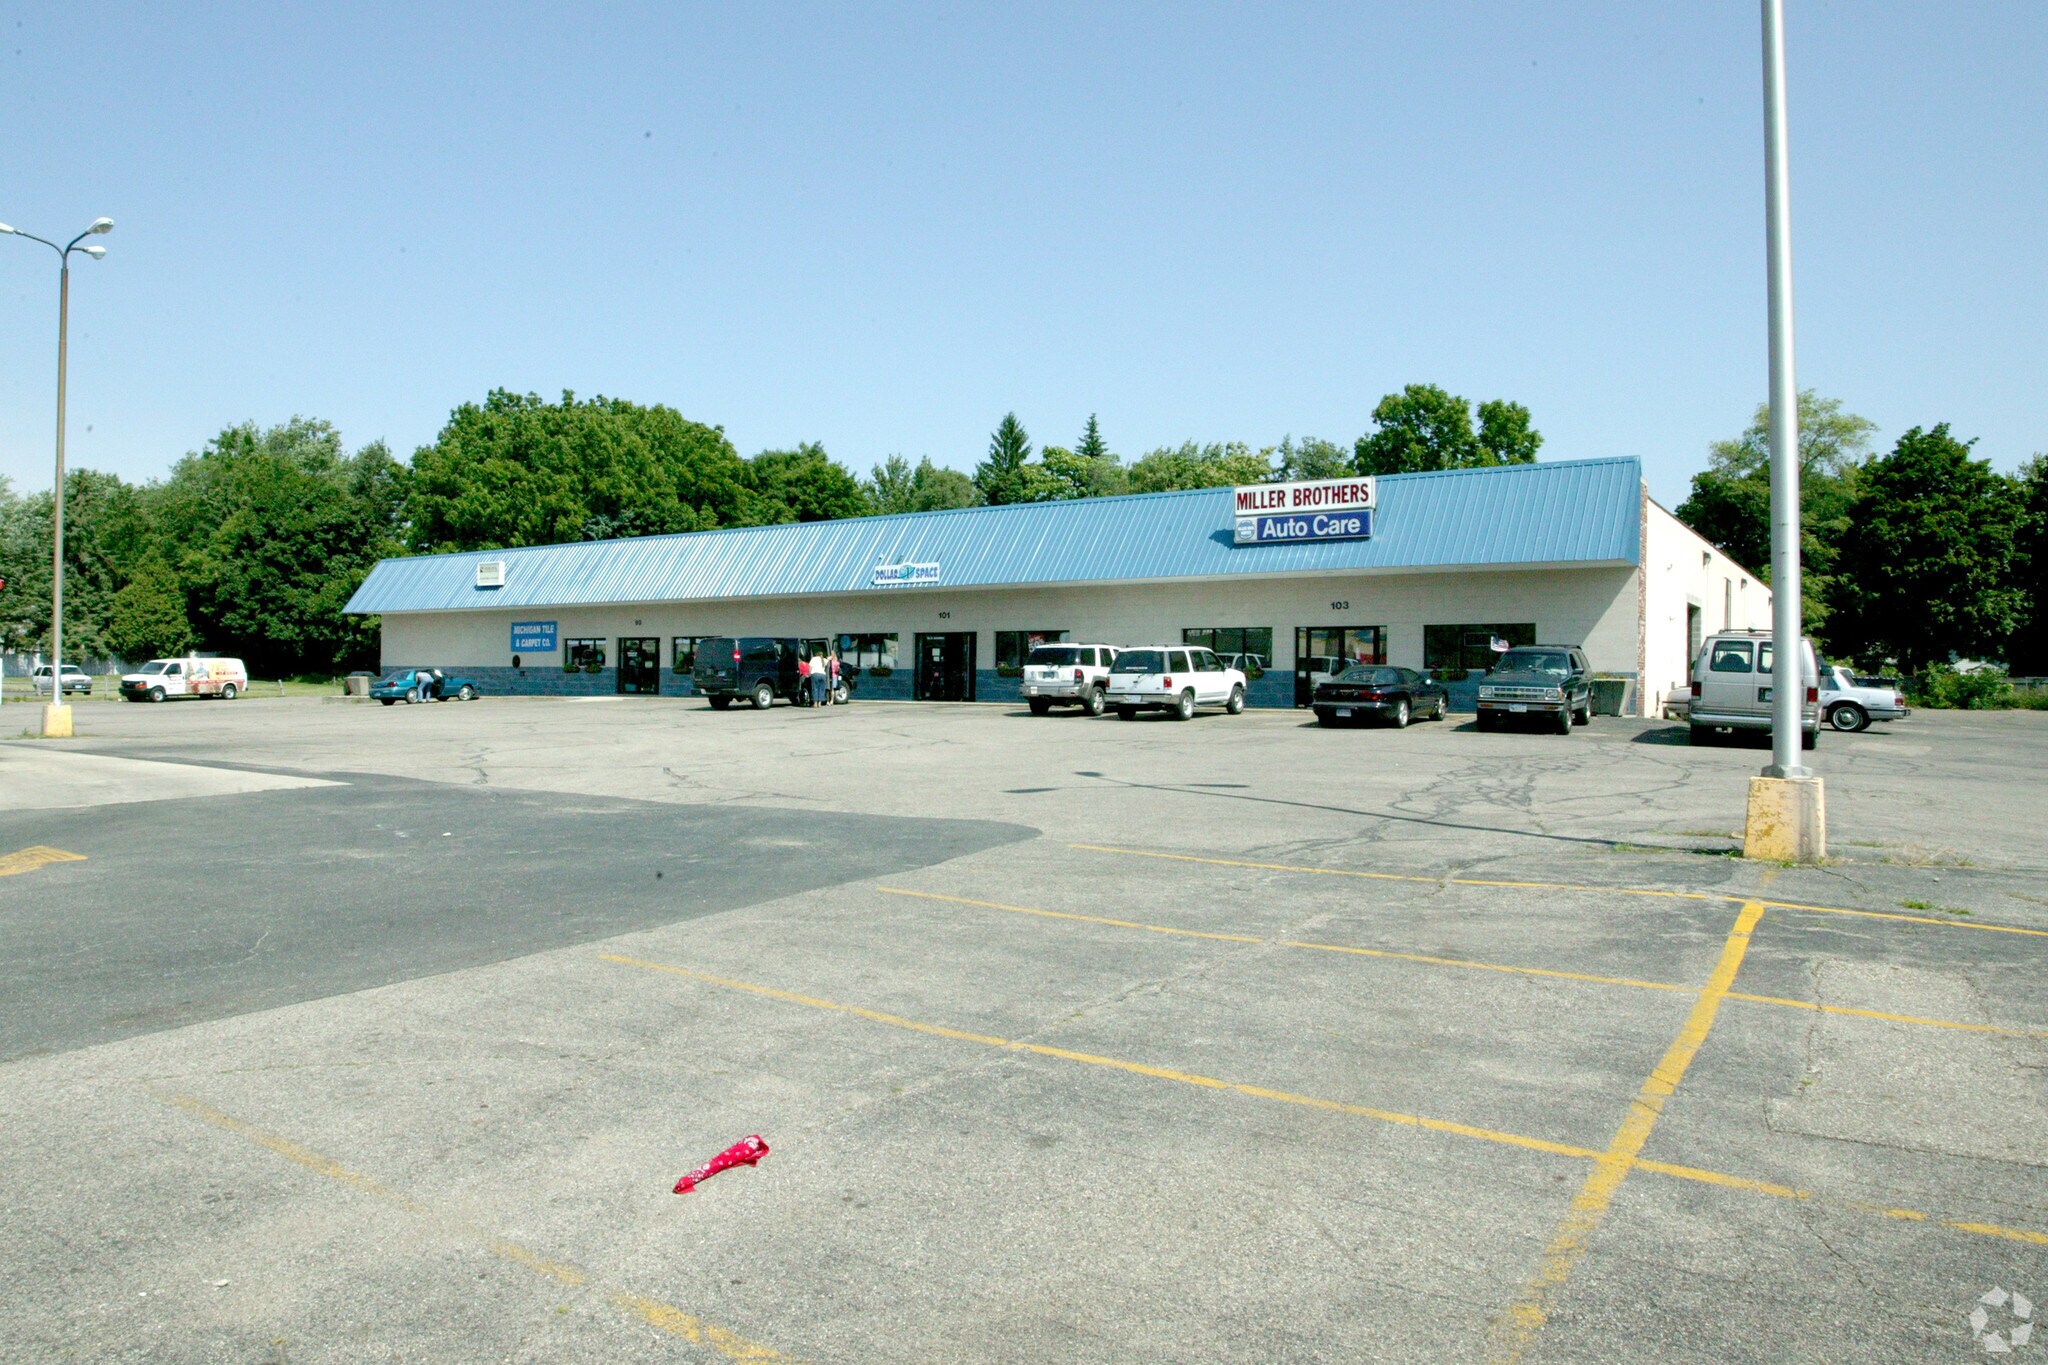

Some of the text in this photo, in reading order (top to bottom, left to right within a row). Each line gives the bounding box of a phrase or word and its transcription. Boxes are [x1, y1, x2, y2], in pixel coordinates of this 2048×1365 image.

[1237, 483, 1369, 510] MILLER BROTHERS
[1262, 518, 1308, 538] Auto
[1313, 515, 1361, 536] Care
[876, 569, 898, 580] DOLLAR
[915, 567, 938, 578] SPACE
[1331, 601, 1349, 610] 103
[513, 624, 555, 635] MICHIGAN TILE
[521, 638, 541, 647] CARPET
